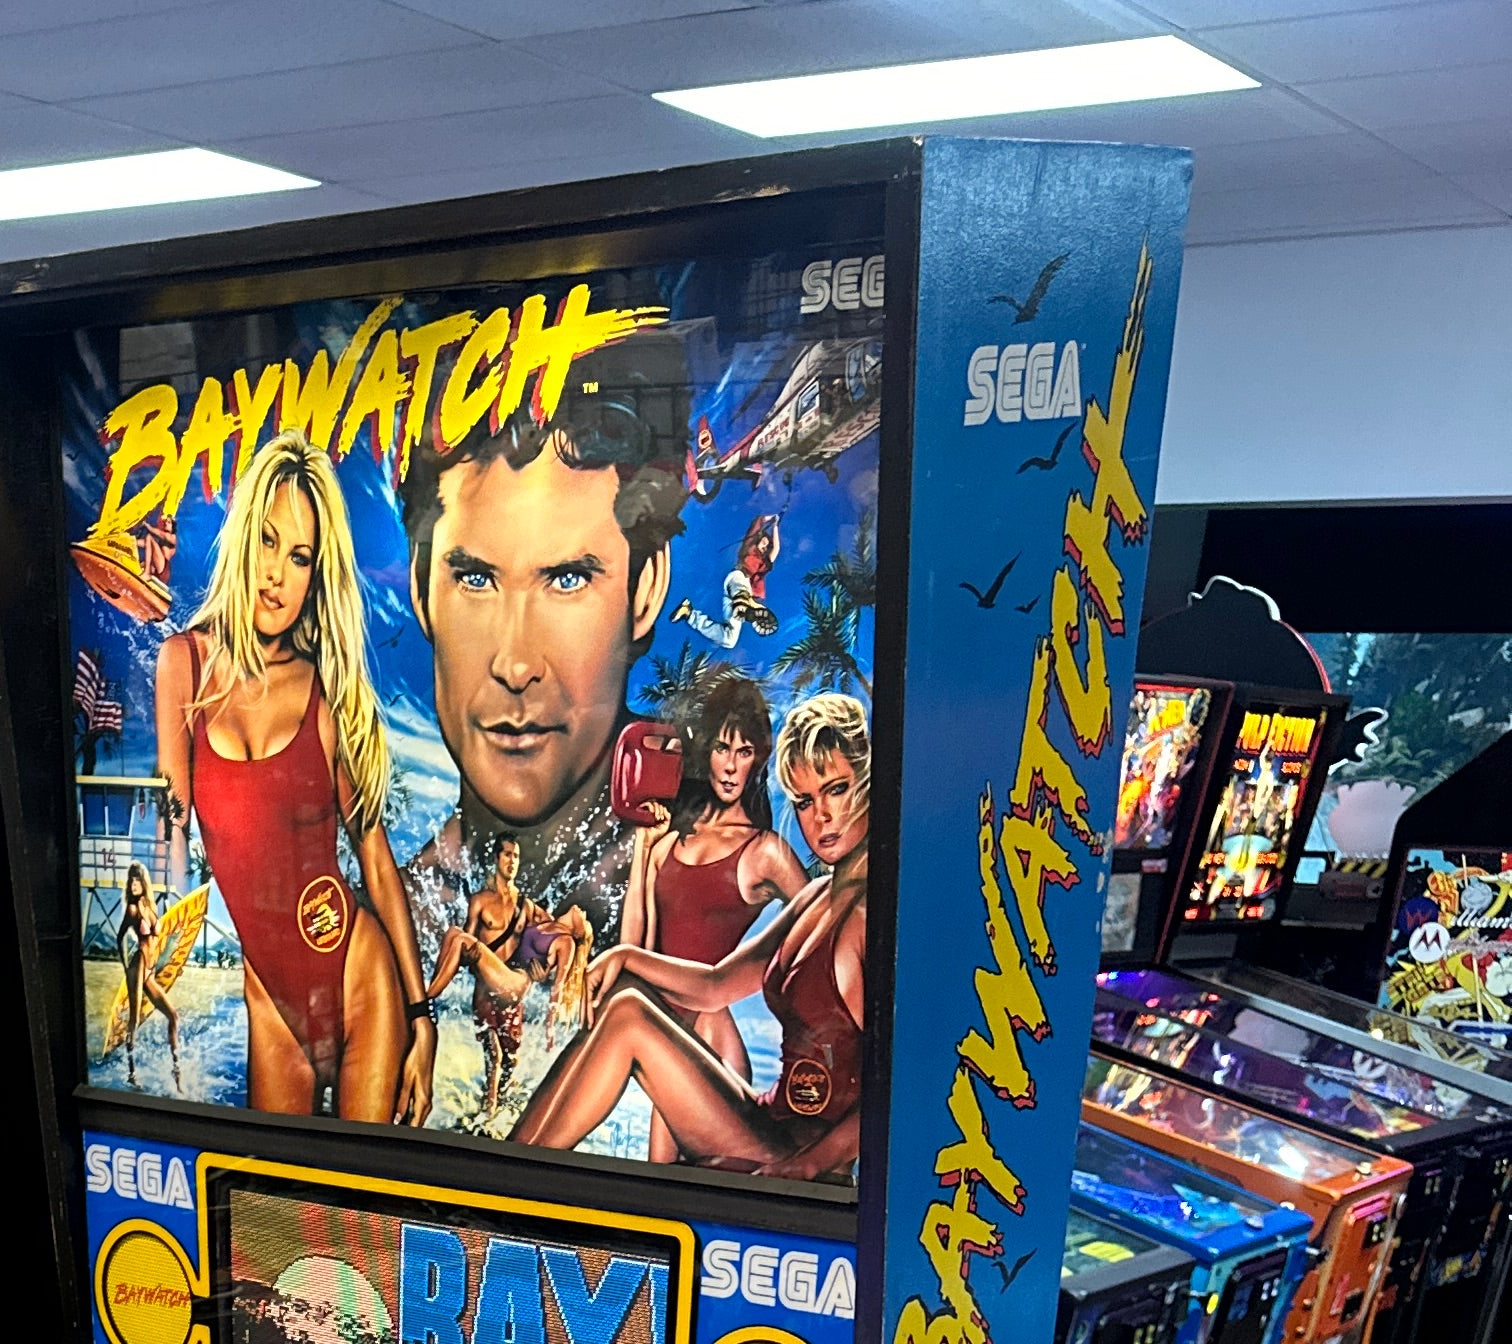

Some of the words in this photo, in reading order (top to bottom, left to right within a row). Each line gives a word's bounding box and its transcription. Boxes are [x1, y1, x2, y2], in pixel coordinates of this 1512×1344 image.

[87, 282, 671, 538] BAYWATCH
[964, 340, 1082, 427] SEGA
[87, 1145, 194, 1209] SEGA
[114, 1280, 192, 1310] BAYWATCH
[701, 1239, 856, 1319] SEGA
